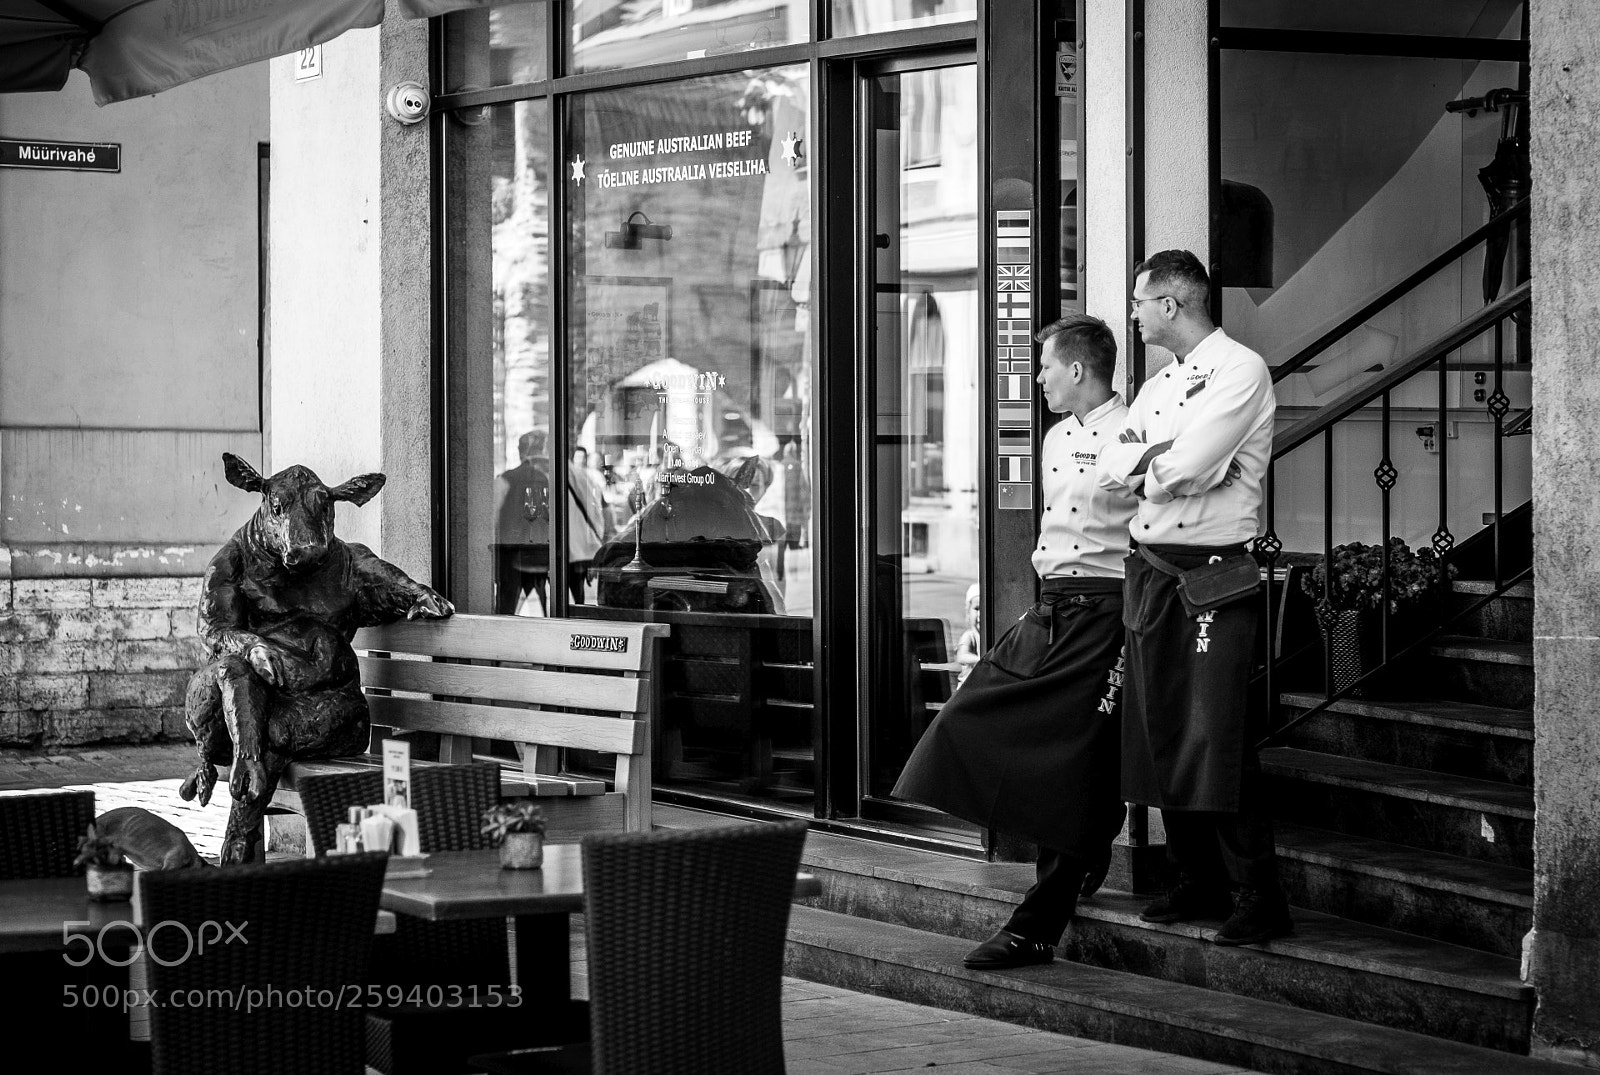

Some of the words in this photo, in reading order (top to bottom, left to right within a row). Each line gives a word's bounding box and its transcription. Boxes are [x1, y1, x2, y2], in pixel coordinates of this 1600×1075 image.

[300, 47, 315, 70] 22
[18, 145, 96, 163] Müürivahe
[609, 141, 656, 160] GENUINE
[656, 132, 723, 155] AUSTRALIAN
[725, 130, 752, 147] BEEF
[597, 168, 640, 189] TÕELINE
[641, 164, 707, 185] AUSTRAALIA
[708, 158, 767, 179] VEISELIHA
[669, 472, 686, 483] Invest
[687, 473, 704, 486] Group
[574, 635, 619, 651] GOODWIN
